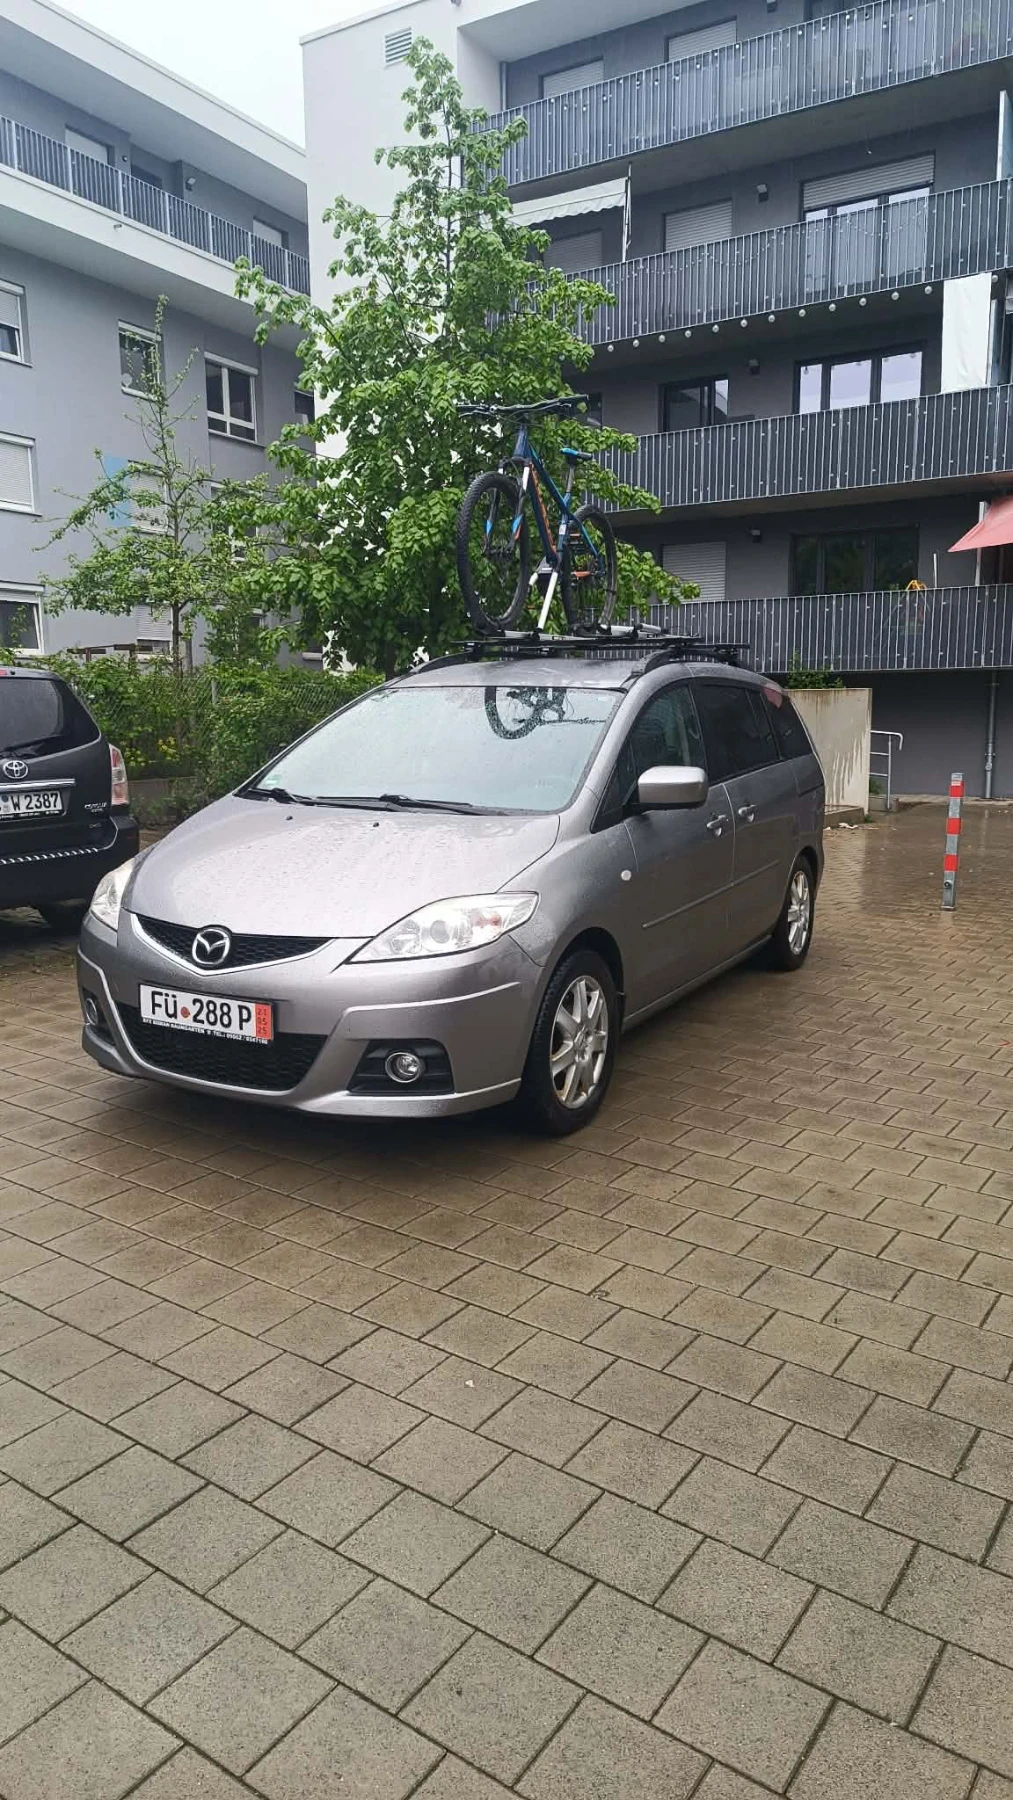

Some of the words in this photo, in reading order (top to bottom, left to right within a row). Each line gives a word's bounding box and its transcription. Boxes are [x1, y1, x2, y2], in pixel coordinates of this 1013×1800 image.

[10, 794, 21, 811] W
[24, 793, 58, 810] 2387
[151, 990, 178, 1020] FÜ
[192, 998, 232, 1029] 288
[238, 1004, 252, 1031] P
[257, 1008, 267, 1016] 21
[257, 1026, 267, 1035] 25
